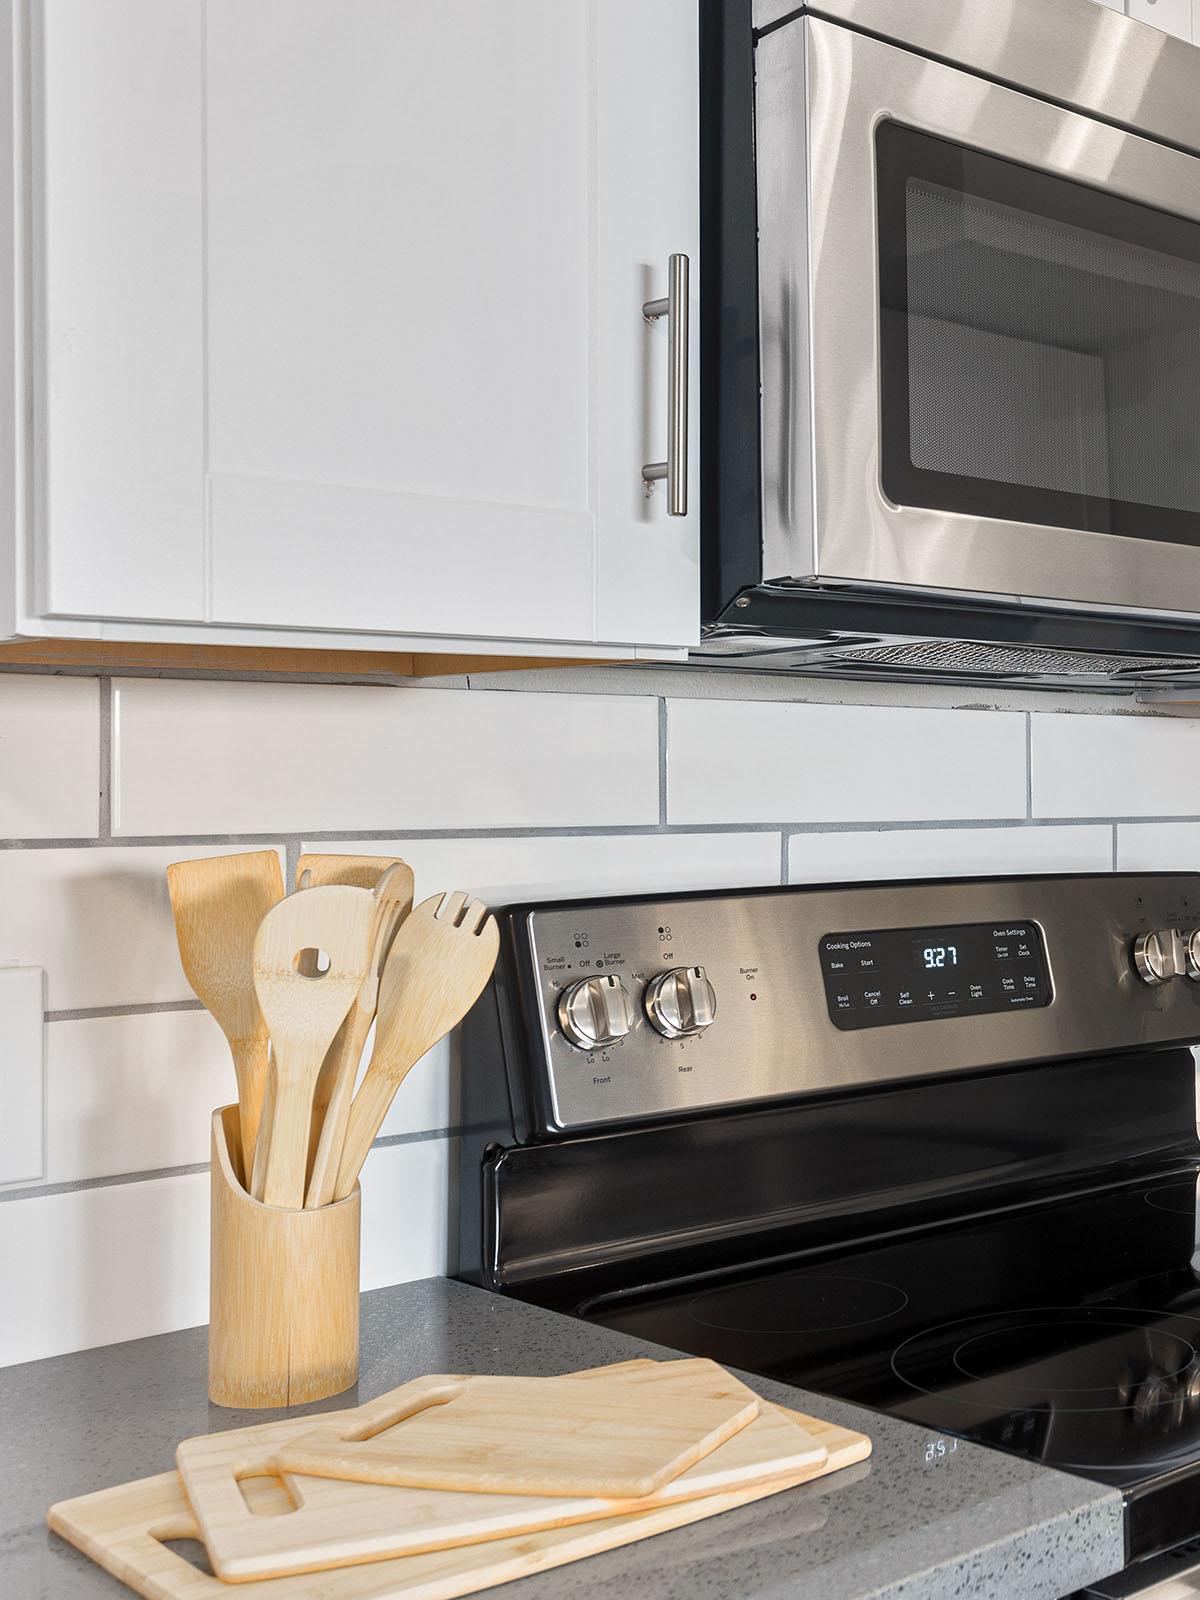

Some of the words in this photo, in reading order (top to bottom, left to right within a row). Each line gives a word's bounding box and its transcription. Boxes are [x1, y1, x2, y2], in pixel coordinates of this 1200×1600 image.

[1006, 928, 1026, 936] Settings
[850, 941, 872, 949] Options
[547, 956, 565, 964] Small
[603, 952, 621, 960] Large
[860, 959, 874, 967] Start
[740, 967, 758, 975] Burner
[864, 990, 881, 998] Cancel
[971, 990, 983, 998] Light
[593, 1076, 611, 1084] Front
